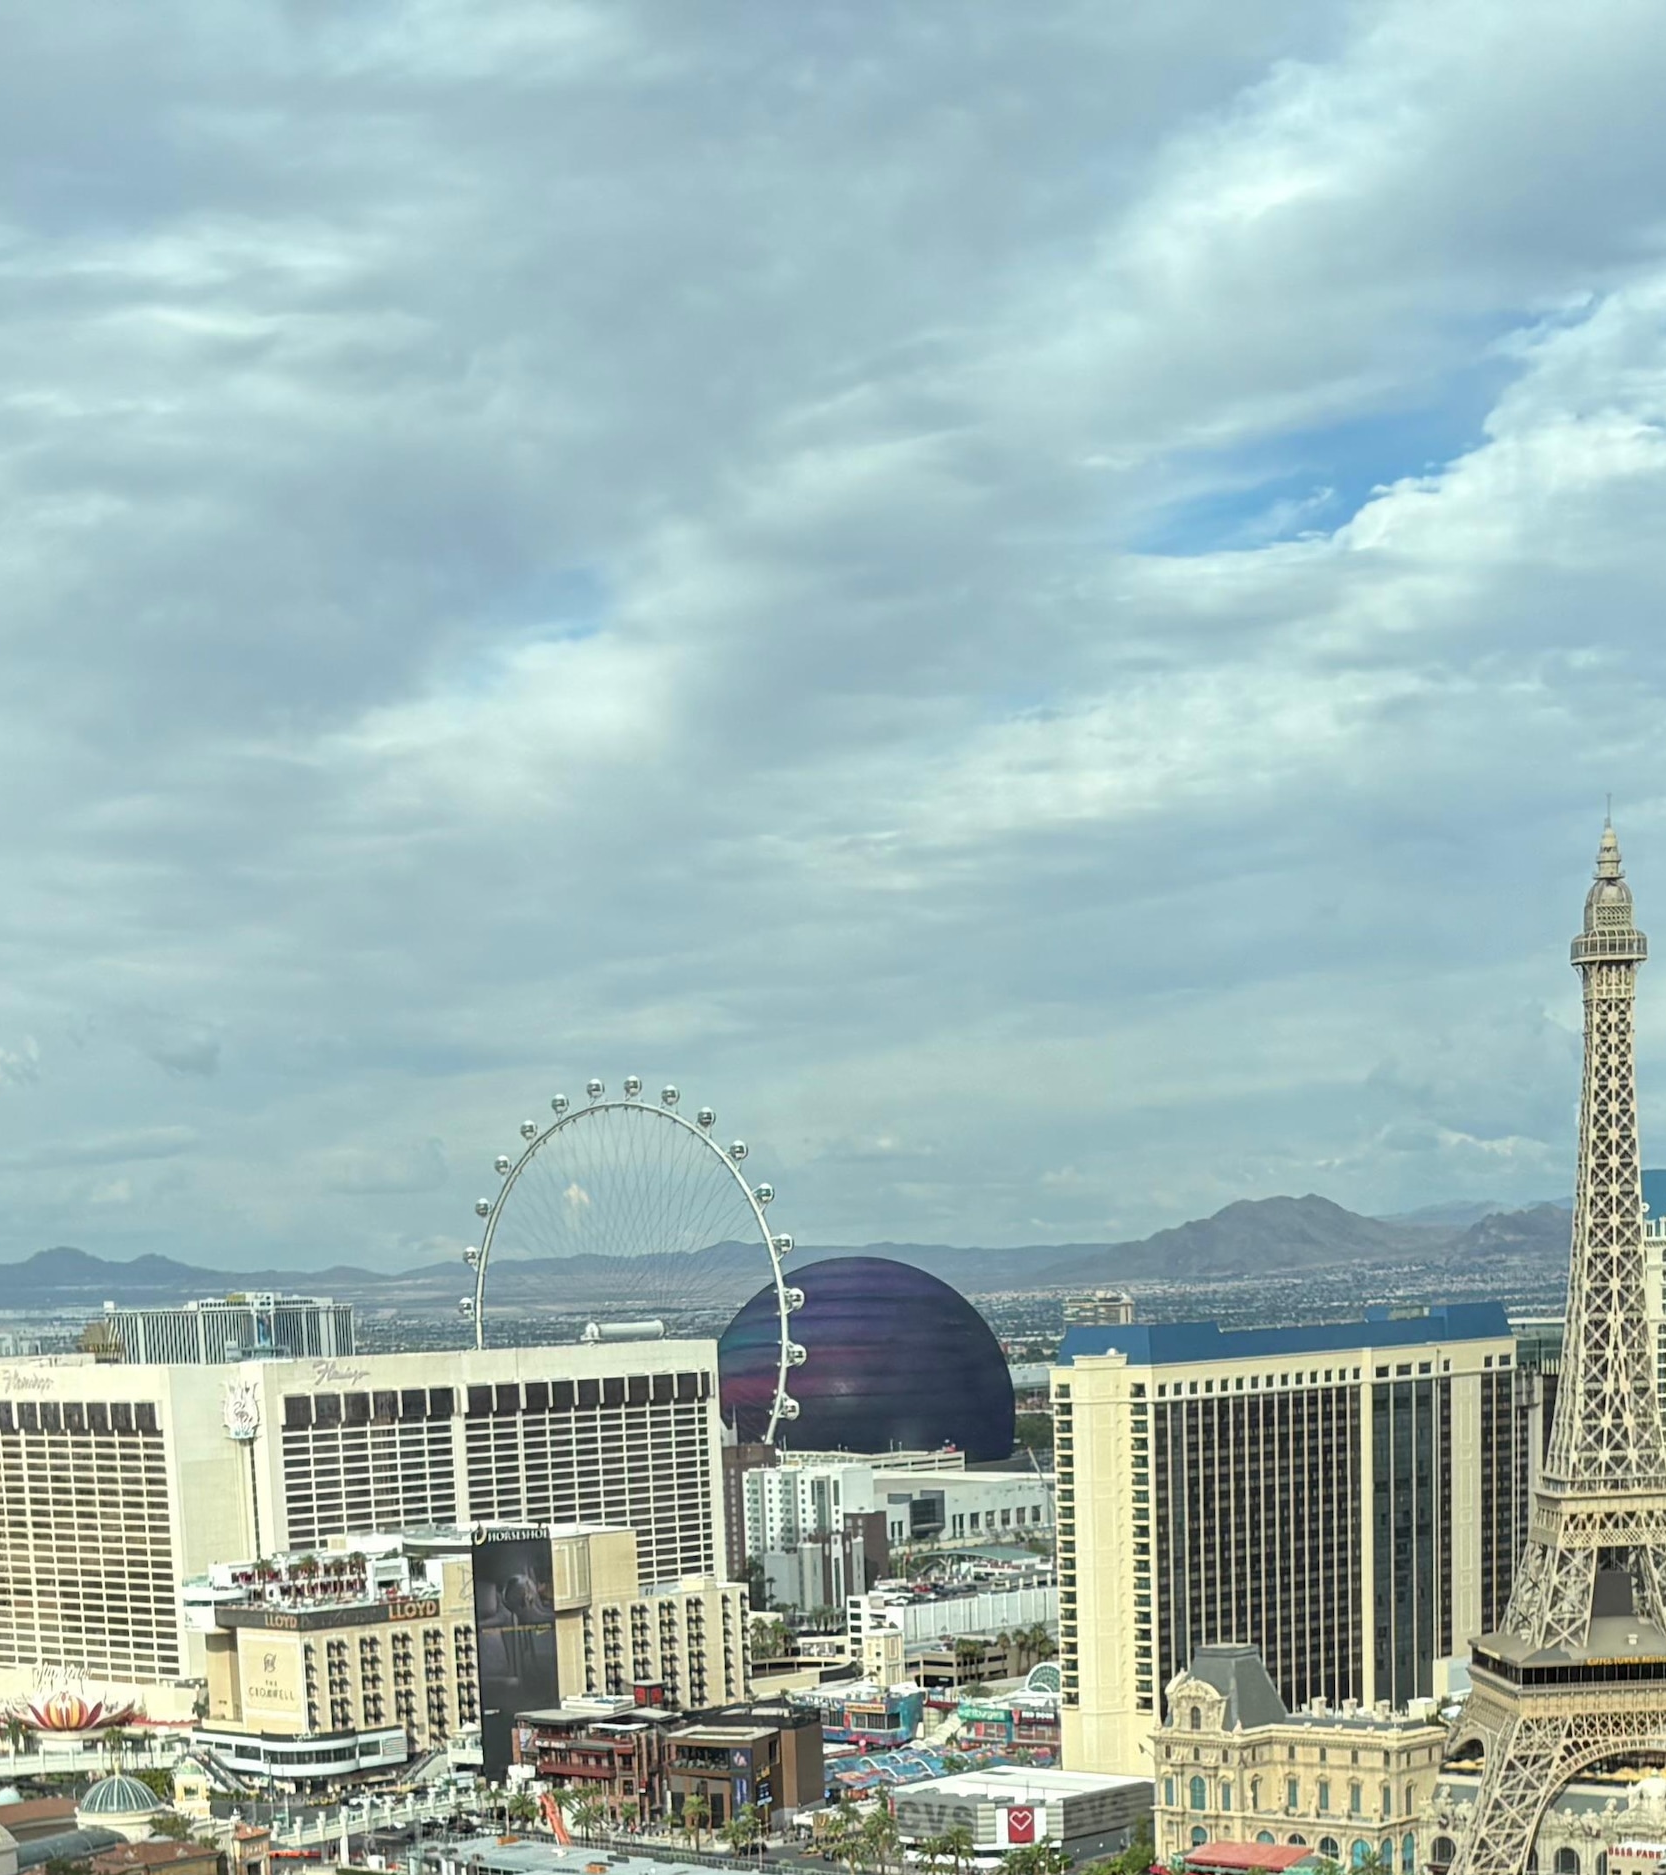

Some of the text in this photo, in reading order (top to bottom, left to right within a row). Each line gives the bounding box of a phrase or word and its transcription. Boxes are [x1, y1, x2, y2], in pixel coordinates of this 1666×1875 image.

[388, 1600, 437, 1620] LLOYD
[264, 1613, 298, 1629] LLOYD
[896, 1800, 976, 1832] CVS
